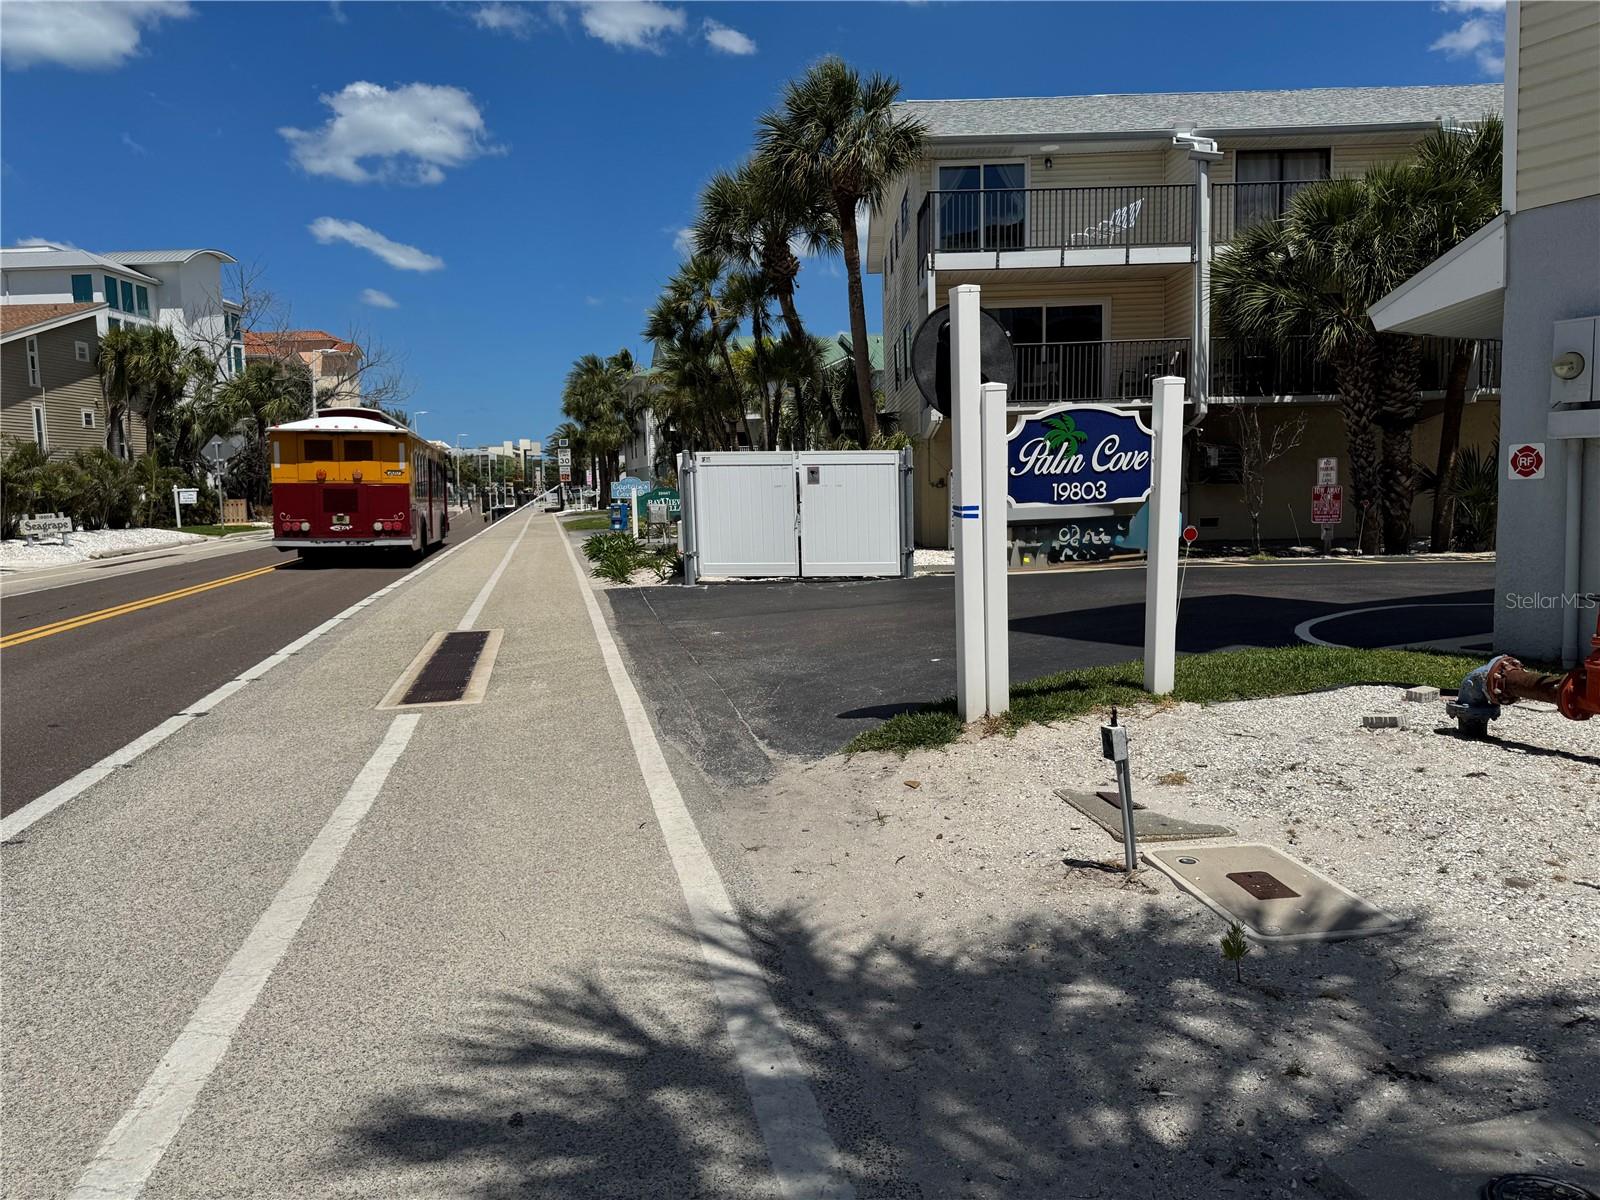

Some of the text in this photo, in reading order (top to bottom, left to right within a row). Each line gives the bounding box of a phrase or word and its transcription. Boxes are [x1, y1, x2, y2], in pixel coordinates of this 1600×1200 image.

[1010, 434, 1149, 475] Palm Cove
[1519, 456, 1534, 466] RF
[1052, 480, 1107, 501] 19803
[24, 521, 69, 532] Seagrape
